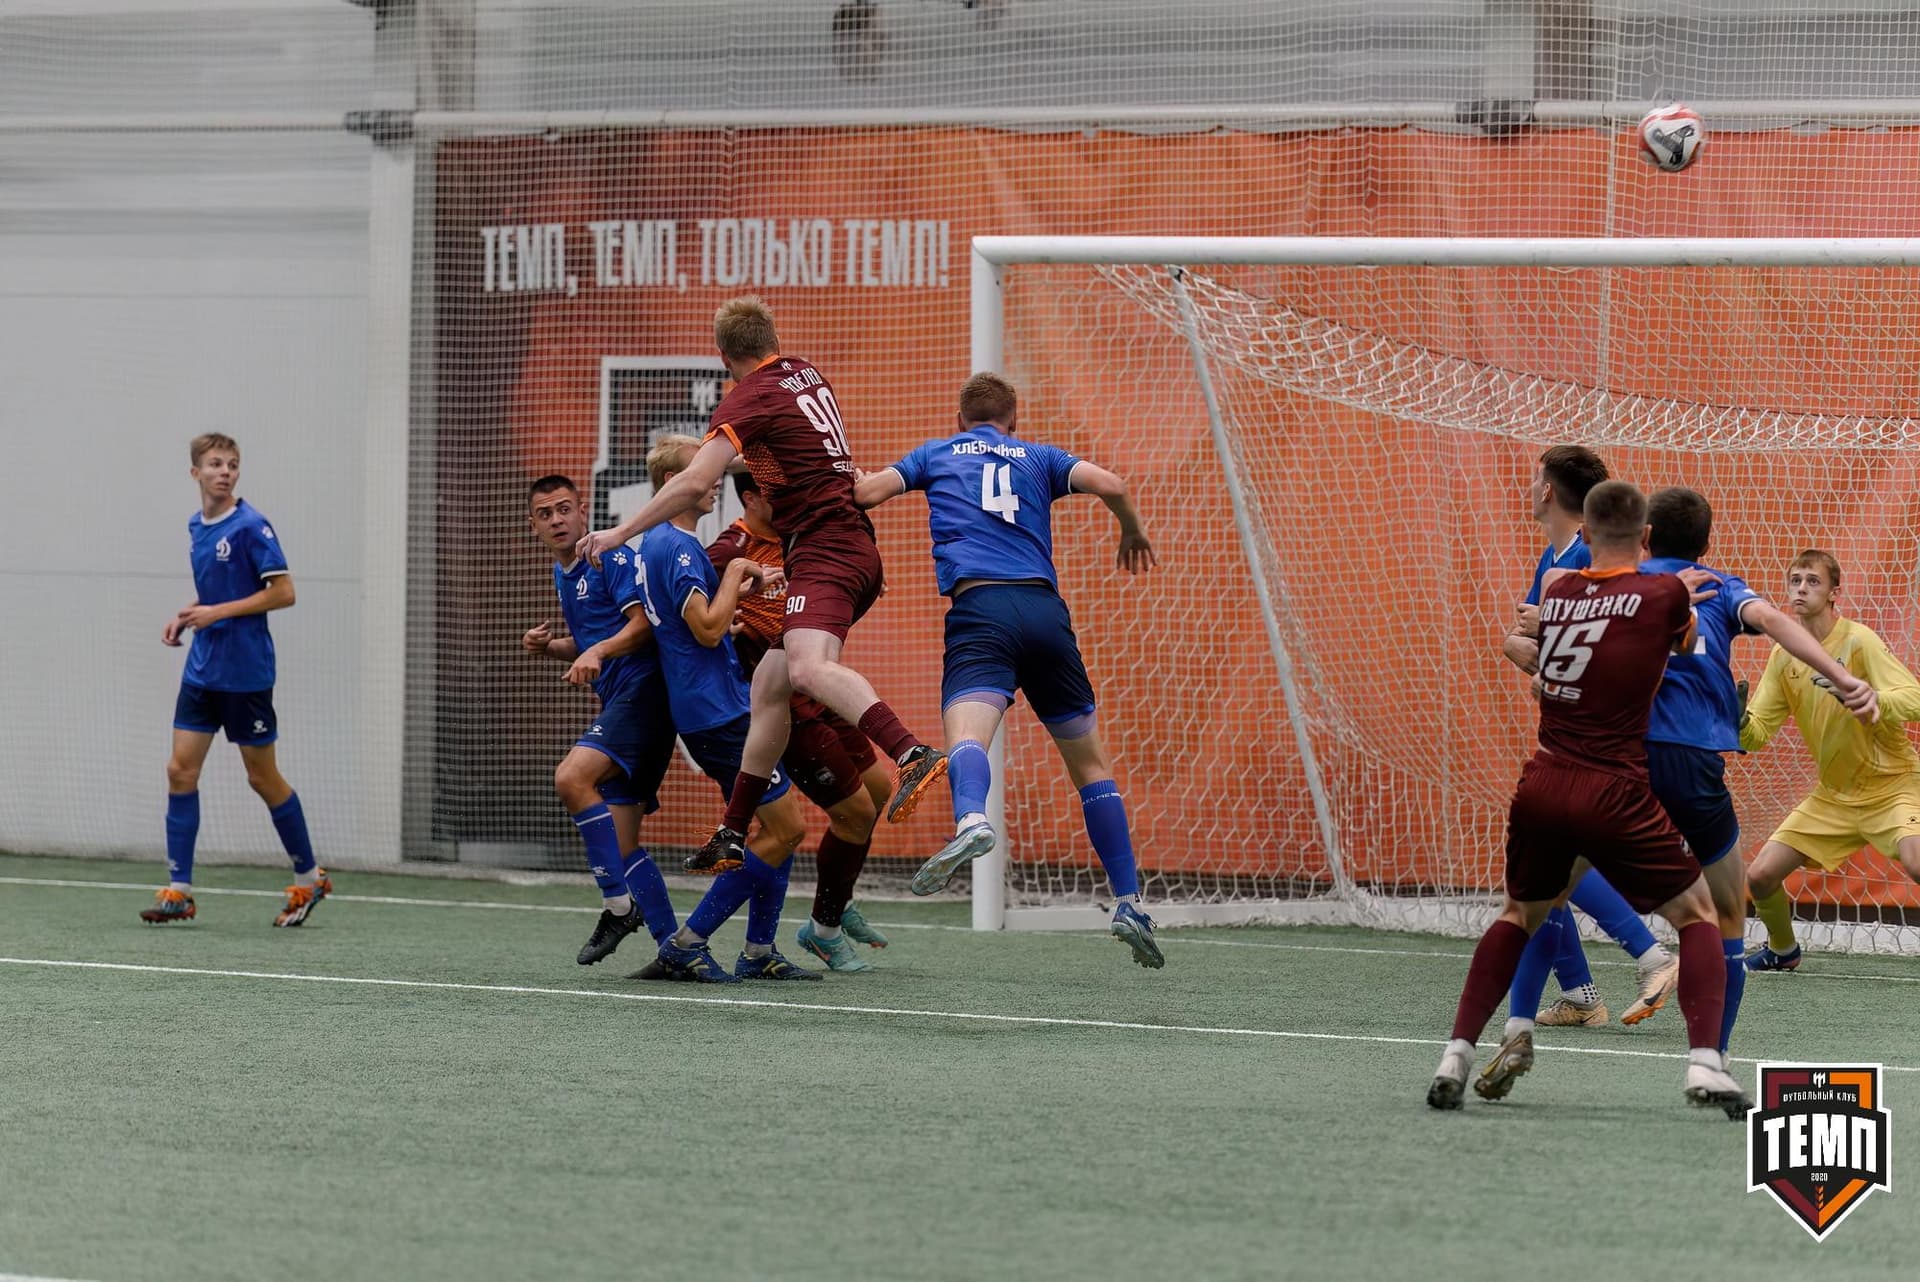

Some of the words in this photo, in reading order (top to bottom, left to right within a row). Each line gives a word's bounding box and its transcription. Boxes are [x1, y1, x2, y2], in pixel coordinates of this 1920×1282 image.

[481, 224, 579, 298] ТЕМП,
[588, 219, 688, 295] ТЕМП,
[699, 218, 832, 287] ТОЛЬКО
[843, 218, 950, 288] ТЕМП!
[796, 387, 851, 457] 90
[981, 462, 1020, 524] 4
[786, 595, 806, 615] 90
[1539, 619, 1610, 682] 15
